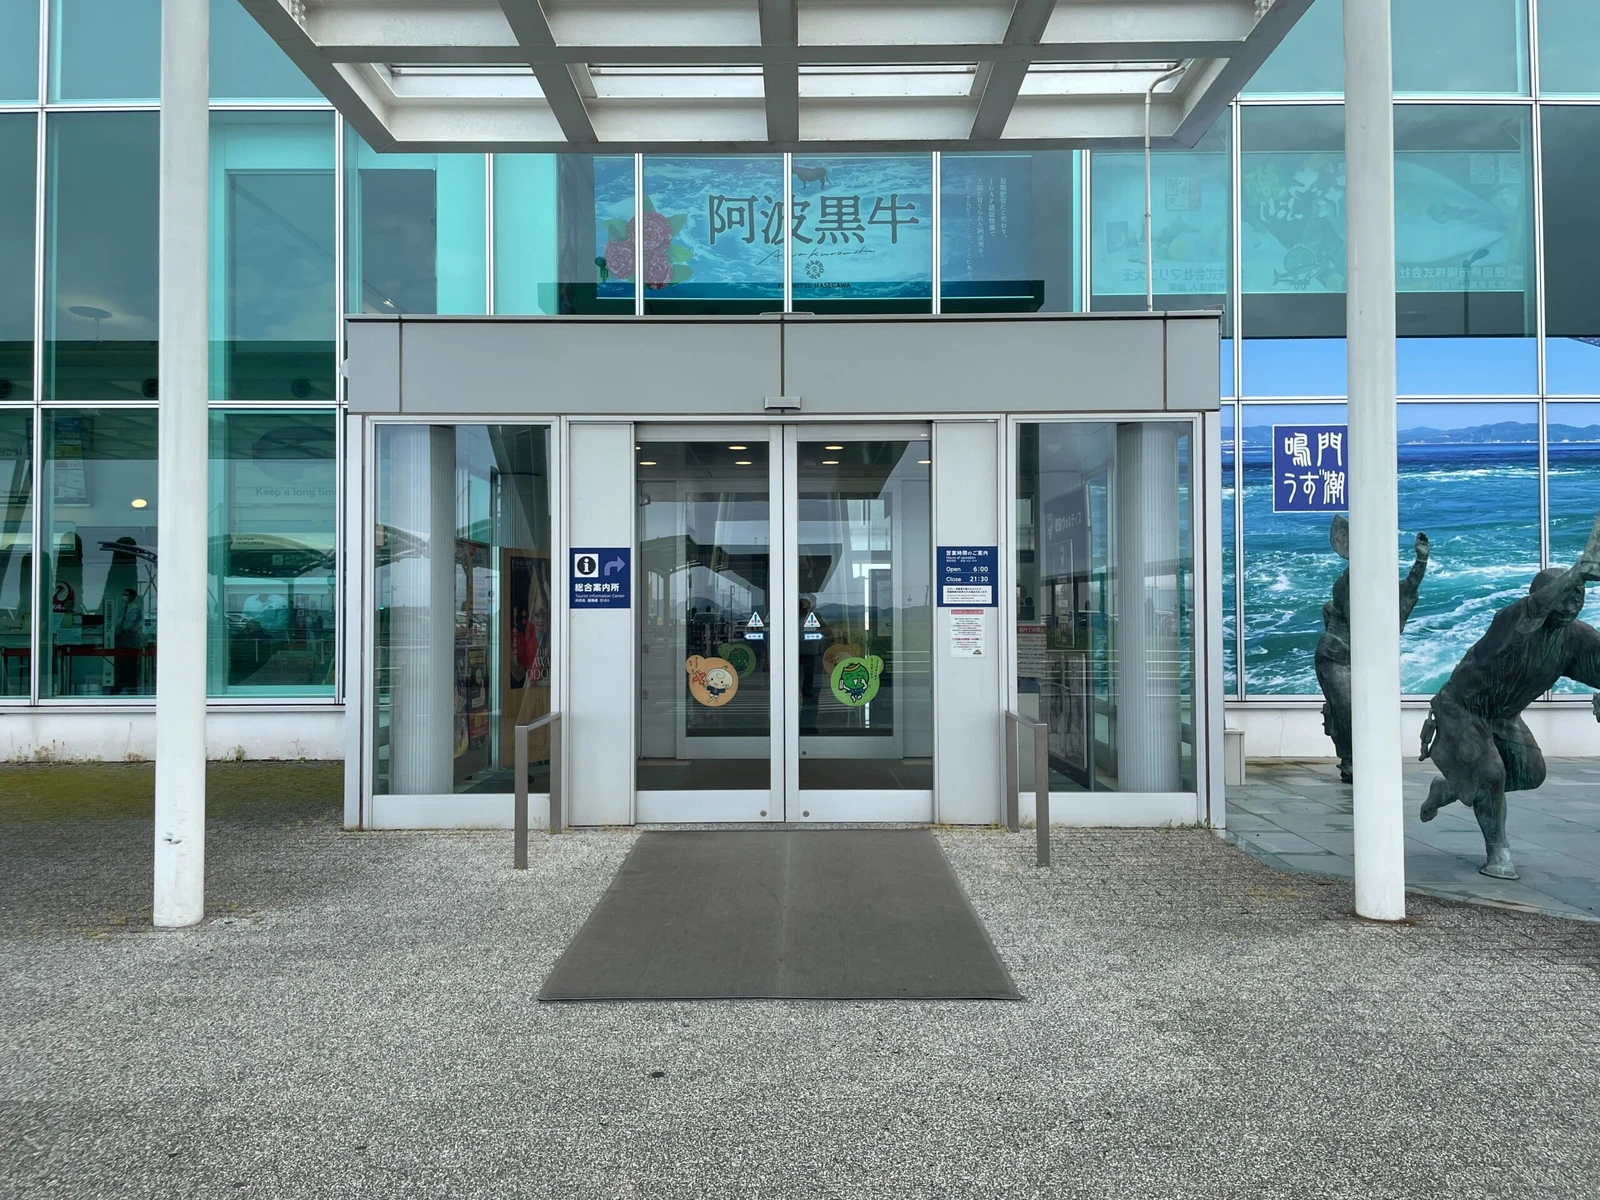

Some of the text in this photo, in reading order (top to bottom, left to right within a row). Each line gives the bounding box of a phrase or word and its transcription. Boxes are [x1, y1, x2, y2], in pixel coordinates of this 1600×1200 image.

[708, 193, 920, 245] 阿波黒牛
[1284, 431, 1343, 468] 鳴門
[255, 487, 282, 498] Keep
[292, 487, 316, 498] long
[318, 488, 336, 496] tim
[1283, 469, 1346, 505] うず潮
[574, 582, 620, 593] 総合案内所
[526, 667, 551, 681] ODO
